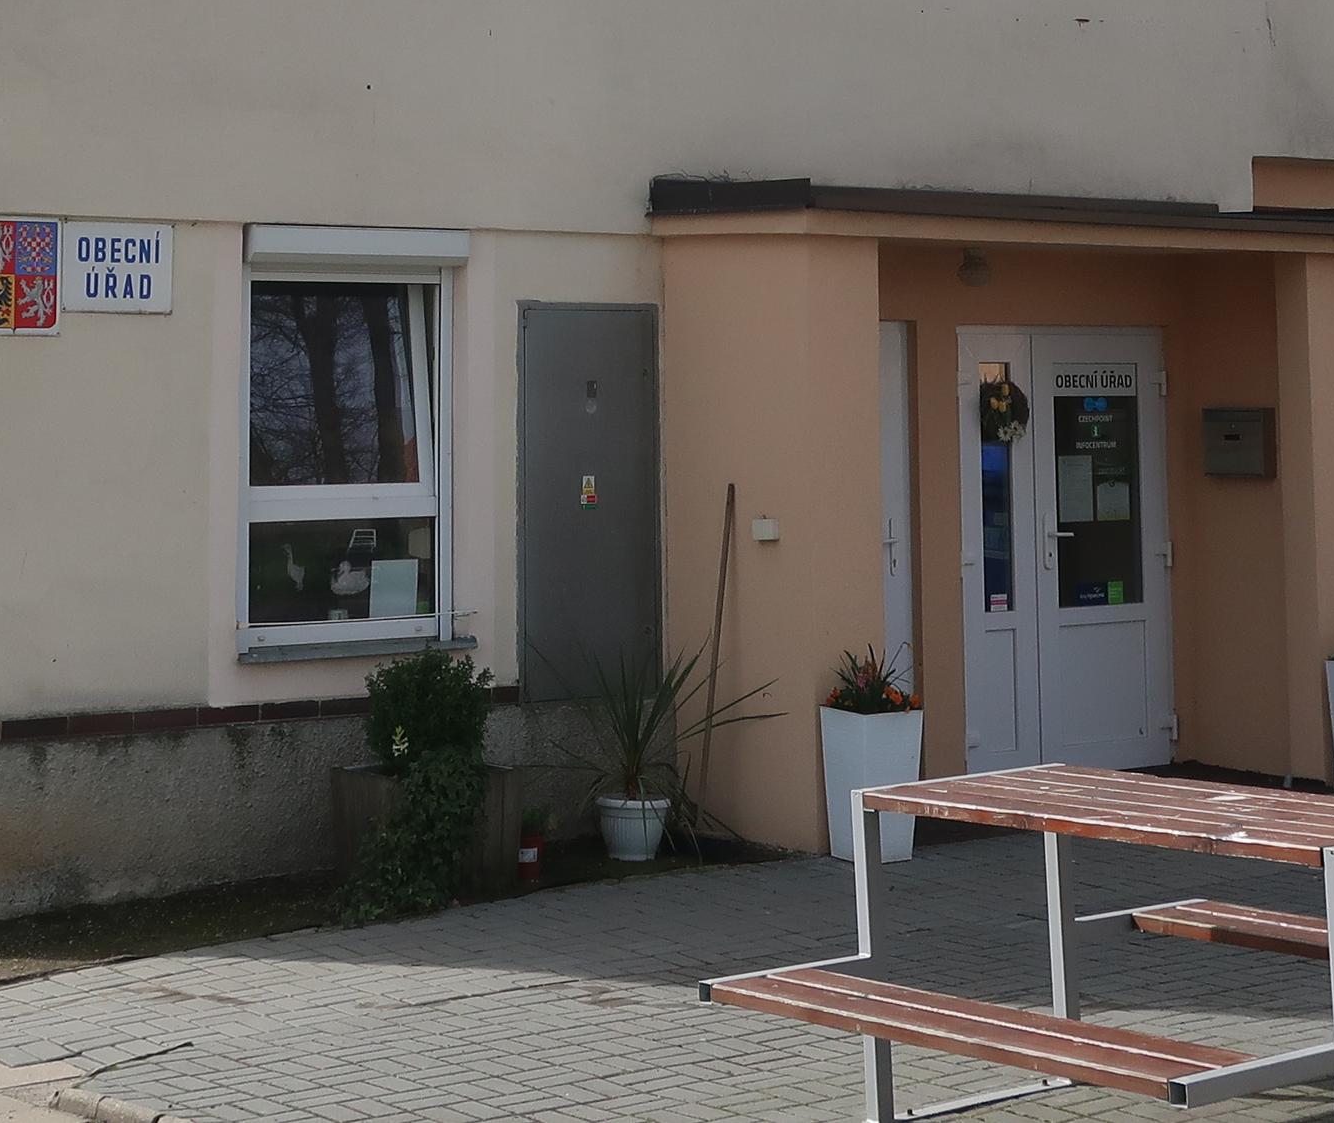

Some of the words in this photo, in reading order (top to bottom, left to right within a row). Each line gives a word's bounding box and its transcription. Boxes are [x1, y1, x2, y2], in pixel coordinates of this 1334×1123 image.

[77, 230, 161, 264] OBECNÍ
[85, 265, 152, 300] ÚŘAD
[1055, 370, 1098, 389] OBECNÍ
[1100, 370, 1133, 389] ÚŘAD
